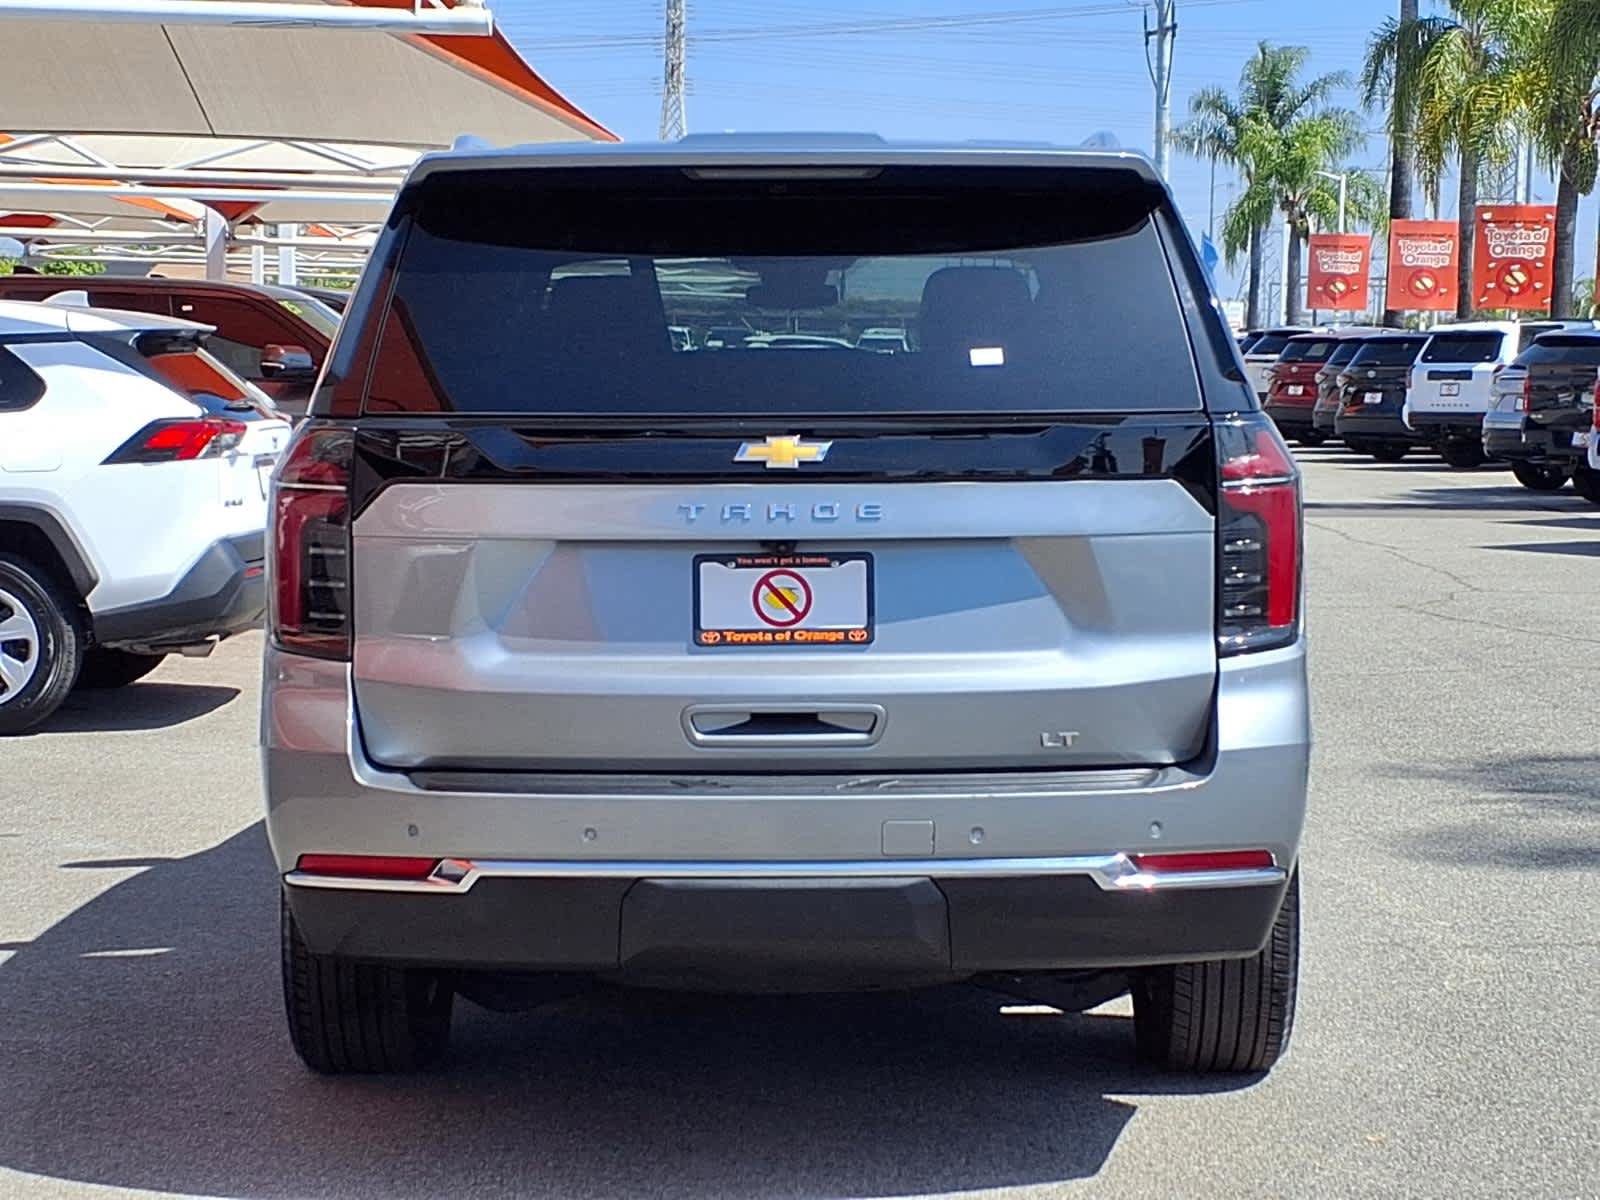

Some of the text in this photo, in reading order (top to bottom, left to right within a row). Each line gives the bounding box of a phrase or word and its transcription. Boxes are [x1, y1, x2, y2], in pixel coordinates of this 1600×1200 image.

[1486, 228, 1548, 243] Toyota of
[1400, 240, 1452, 253] Toyota of
[1491, 243, 1544, 258] Orange
[1404, 254, 1448, 267] Orange
[679, 503, 882, 520] TAHOE
[723, 630, 844, 643] Toyota of Orange
[1040, 731, 1080, 747] LT
